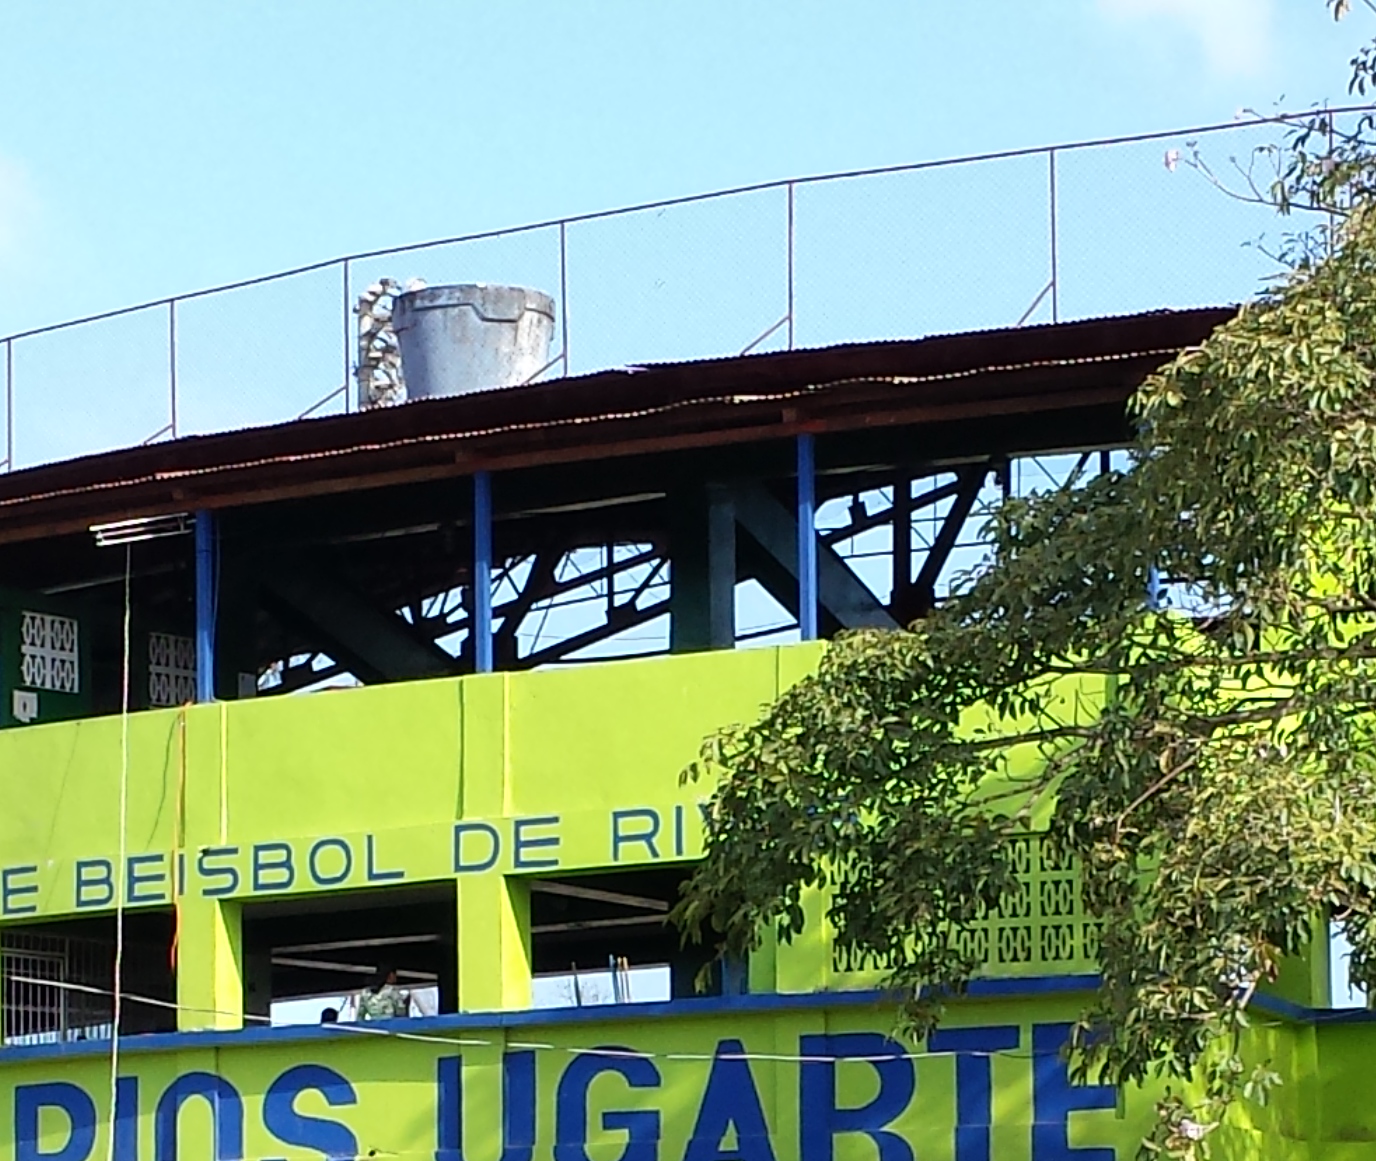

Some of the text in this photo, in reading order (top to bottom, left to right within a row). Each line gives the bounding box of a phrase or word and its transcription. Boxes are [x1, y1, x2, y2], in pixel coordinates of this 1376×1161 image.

[76, 834, 405, 908] BEISBOL
[453, 816, 560, 874] DE
[611, 804, 712, 862] RI
